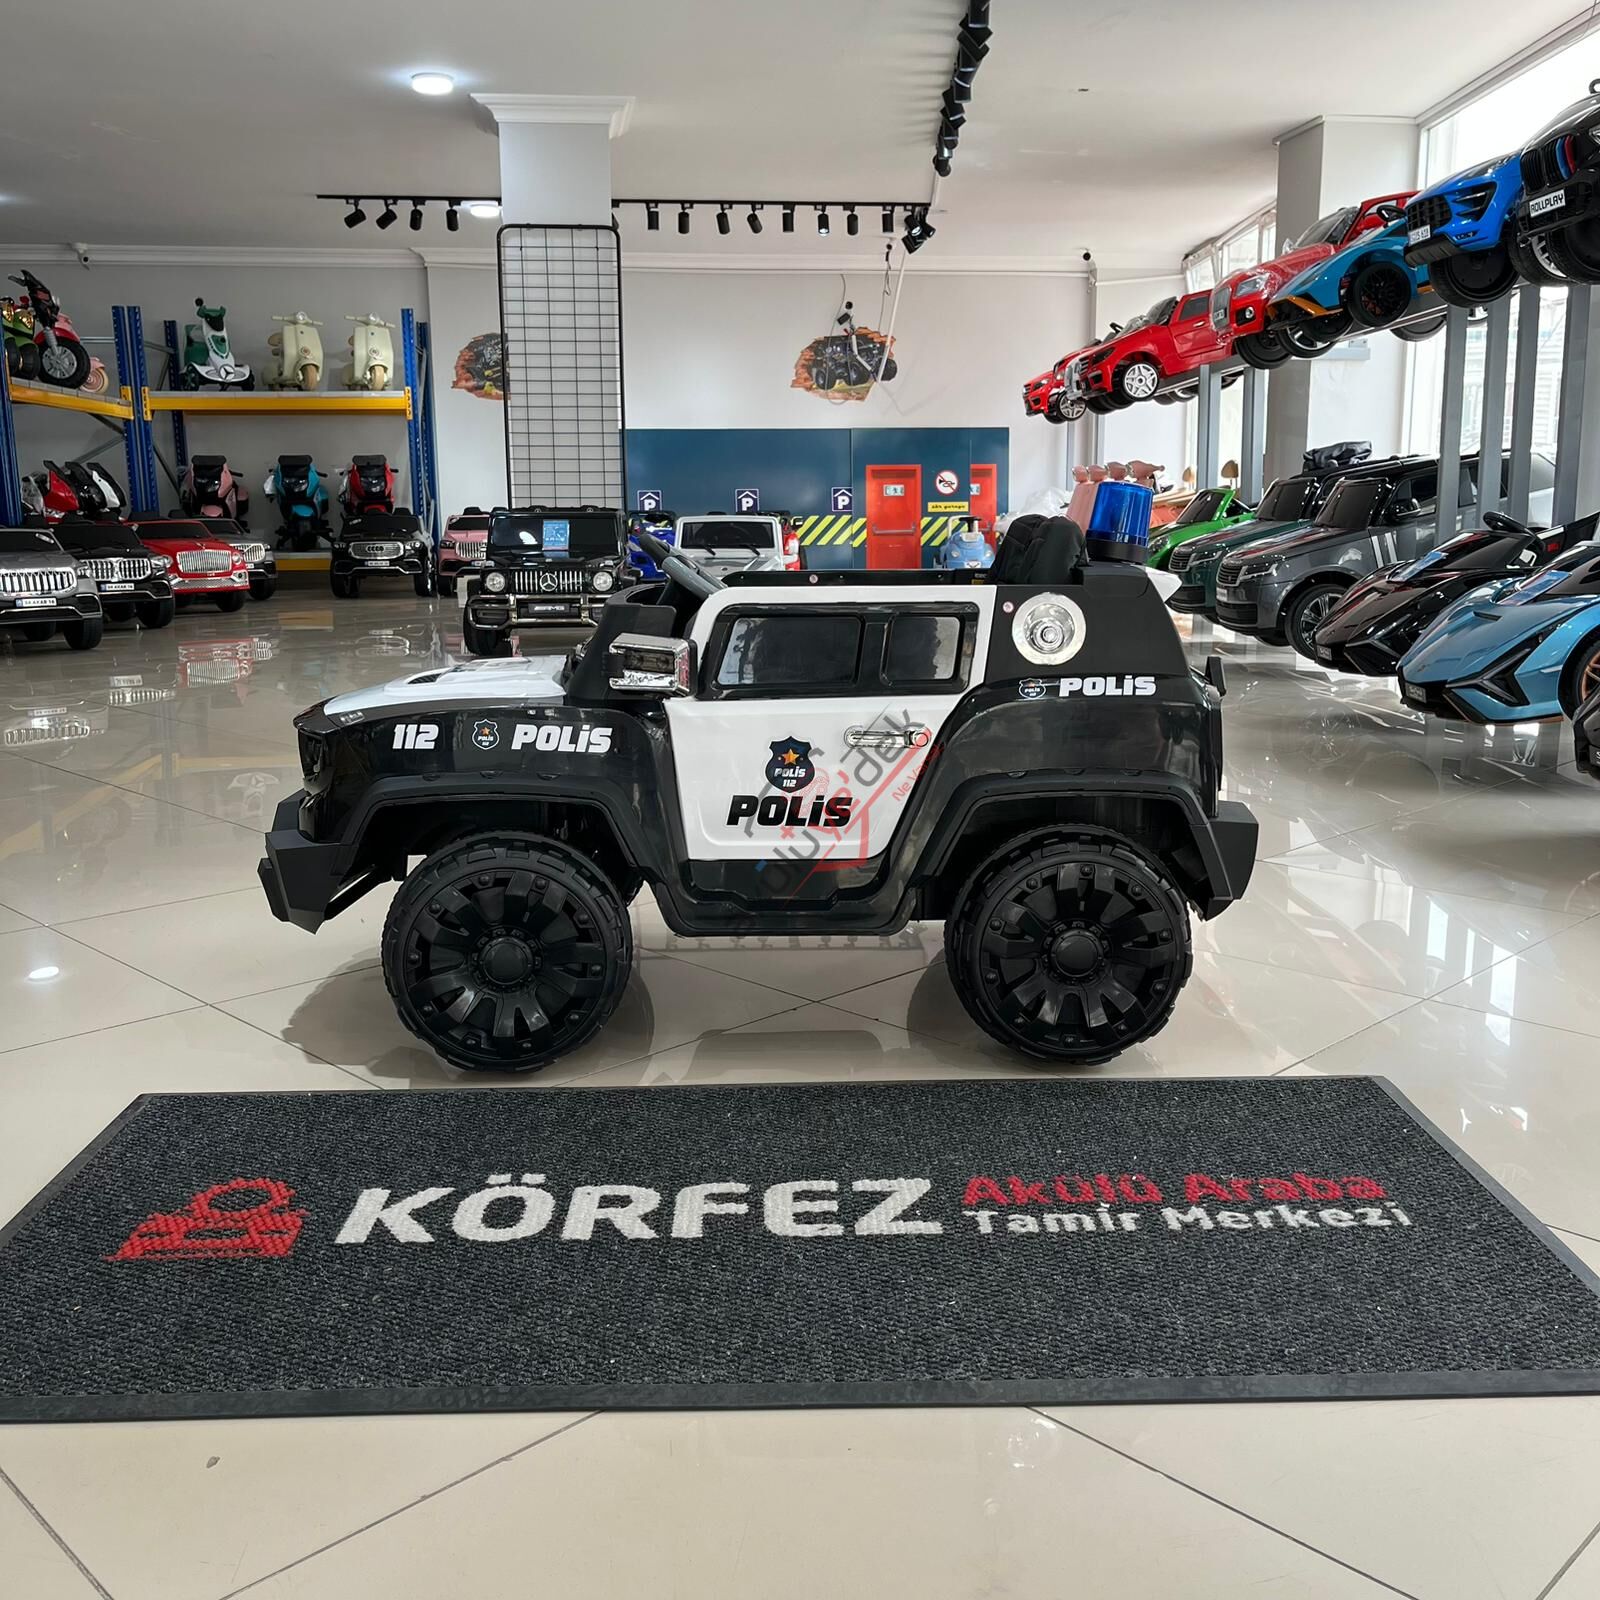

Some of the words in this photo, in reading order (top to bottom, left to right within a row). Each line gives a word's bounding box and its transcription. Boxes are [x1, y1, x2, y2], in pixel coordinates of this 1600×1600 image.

[1530, 193, 1564, 215] ROLLPLAY
[392, 724, 439, 750] 112
[783, 779, 797, 787] 112
[334, 1173, 943, 1245] KÖRFEZ
[962, 1173, 1163, 1206] Akülü
[1185, 1173, 1389, 1203] Araba
[963, 1201, 1138, 1235] Tamir
[1162, 1201, 1412, 1233] Merkezi
